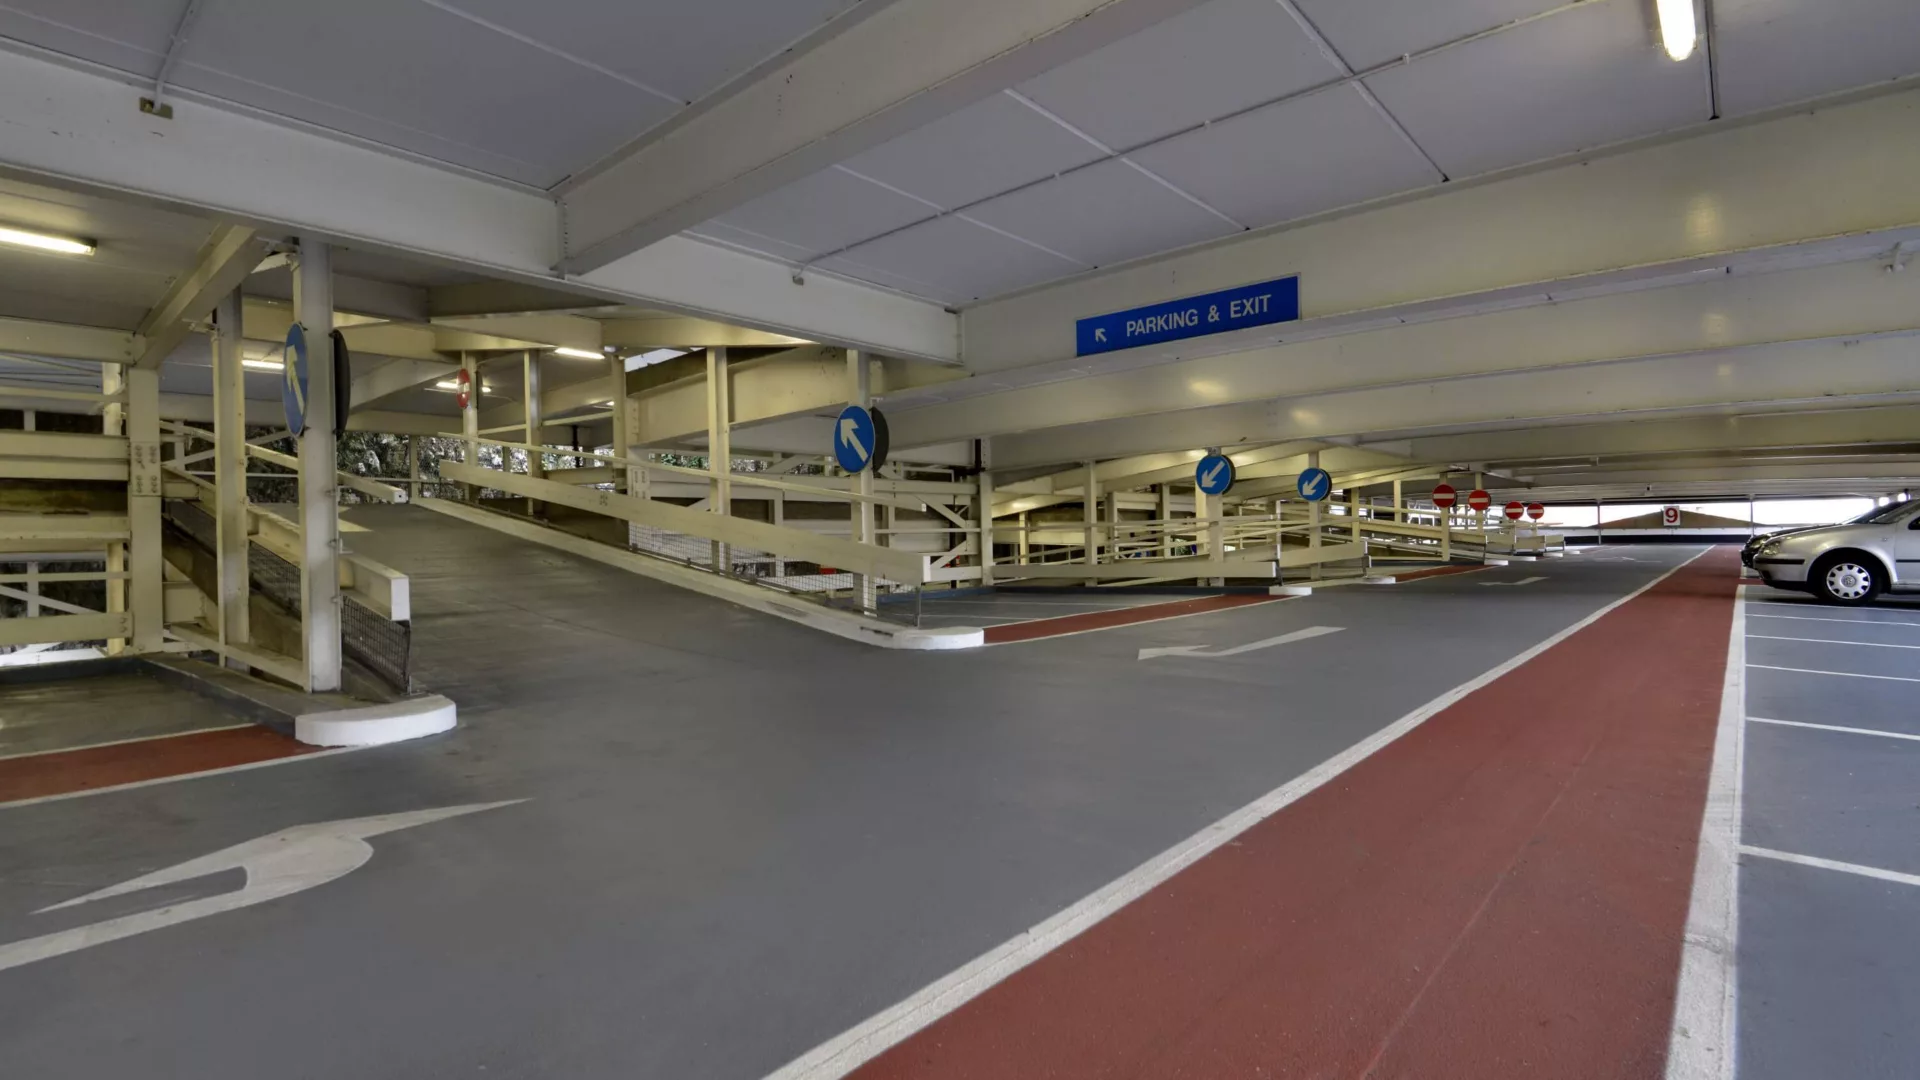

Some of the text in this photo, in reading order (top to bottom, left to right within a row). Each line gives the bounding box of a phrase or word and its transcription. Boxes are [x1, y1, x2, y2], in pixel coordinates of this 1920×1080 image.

[1126, 294, 1272, 337] PARKING & EXIT
[1665, 507, 1678, 523] 9
